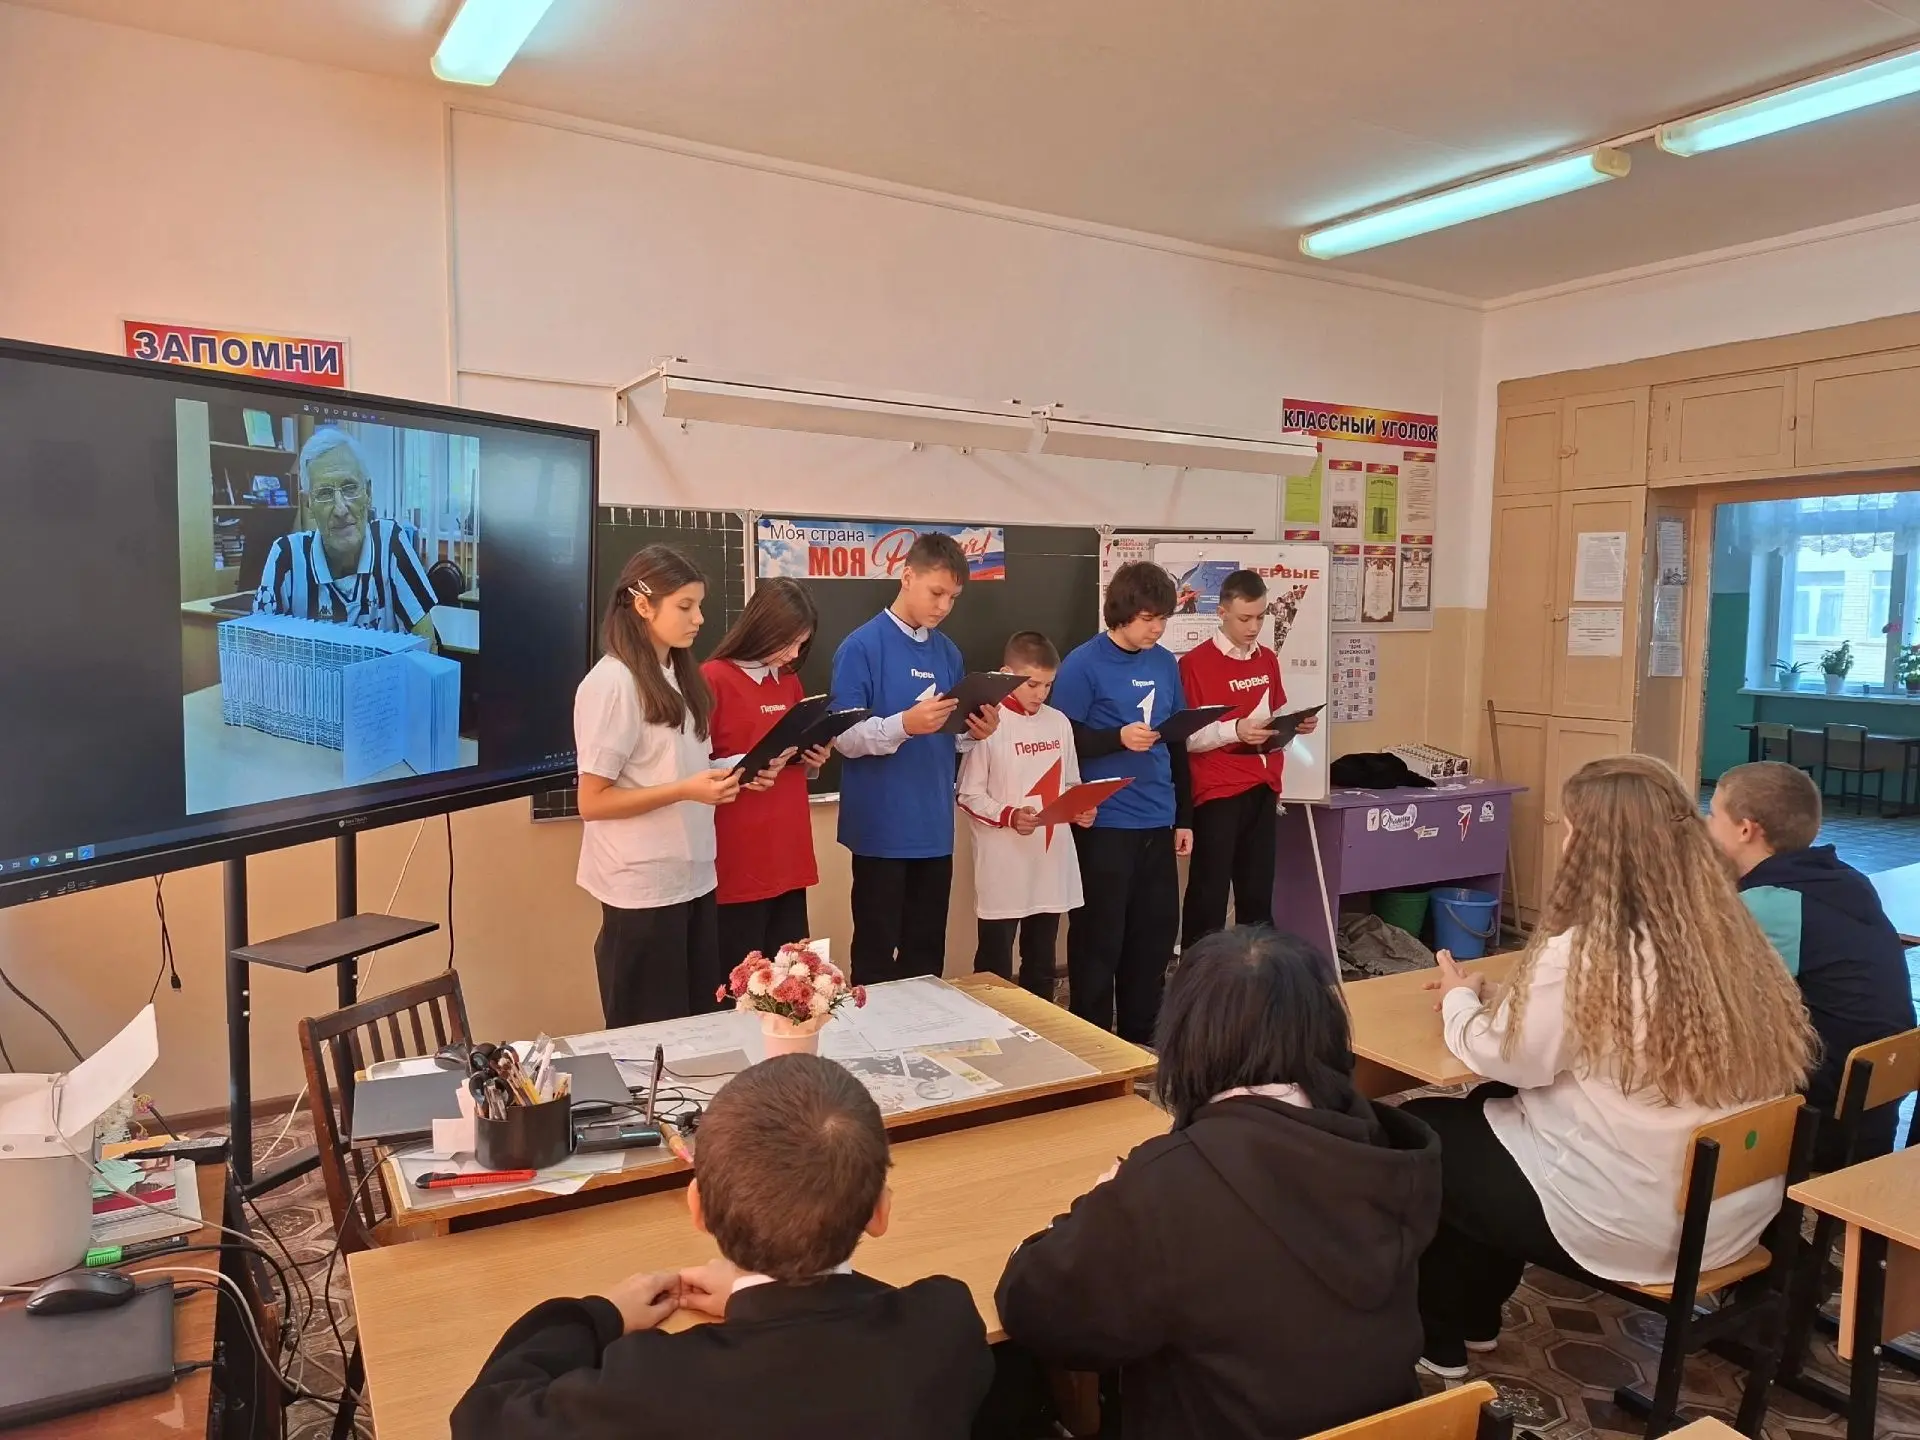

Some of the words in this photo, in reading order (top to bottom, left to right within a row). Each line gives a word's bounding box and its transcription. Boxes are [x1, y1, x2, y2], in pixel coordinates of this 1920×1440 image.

[133, 330, 339, 375] ЗАПОМНИ
[1284, 409, 1376, 436] КЛАССНЫЙ
[1381, 419, 1438, 442] УГОЛОК
[770, 524, 805, 541] Моя
[808, 546, 866, 576] МОЯ
[1228, 674, 1270, 692] Первые
[760, 704, 786, 715] Первые
[1014, 739, 1061, 757] Первые
